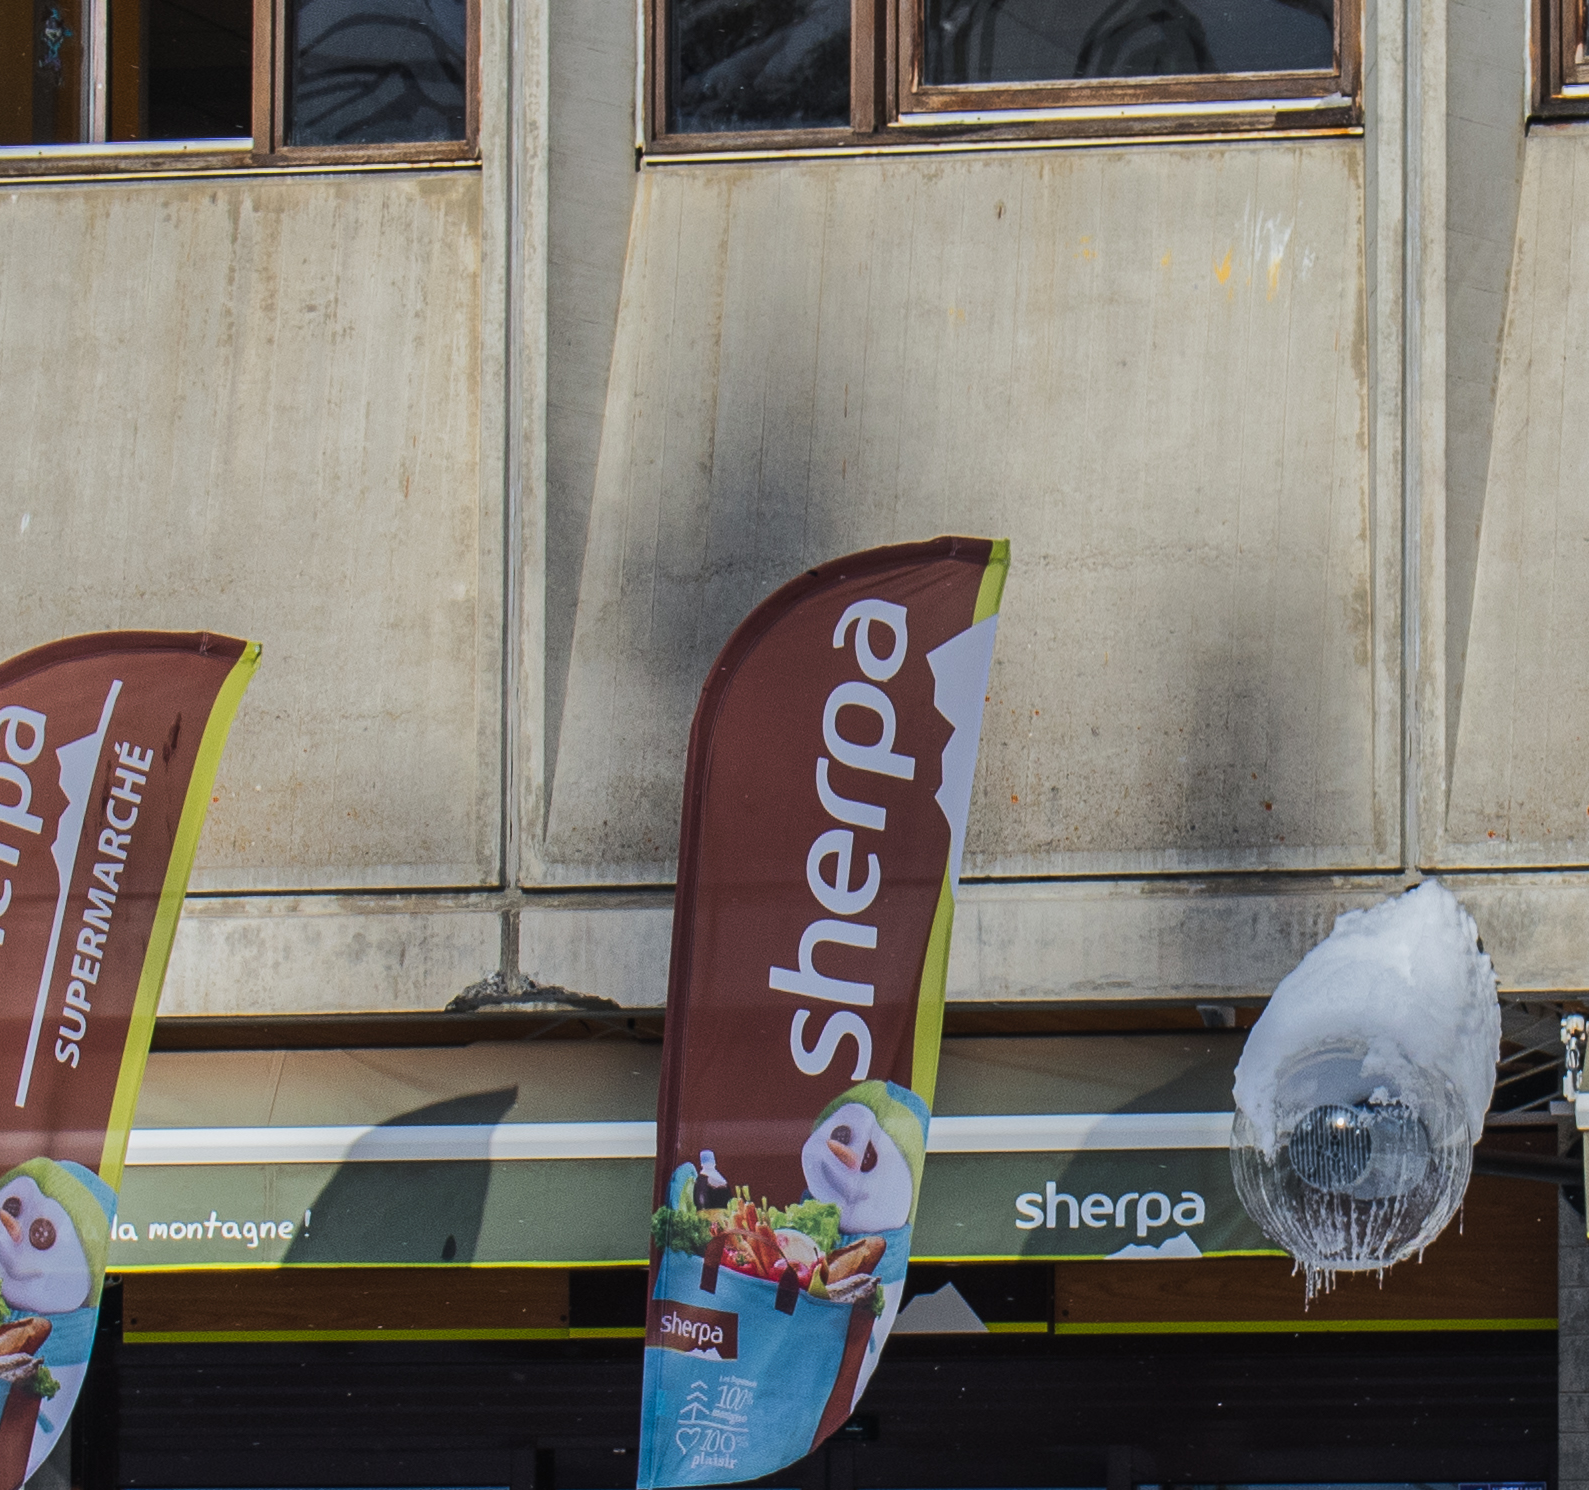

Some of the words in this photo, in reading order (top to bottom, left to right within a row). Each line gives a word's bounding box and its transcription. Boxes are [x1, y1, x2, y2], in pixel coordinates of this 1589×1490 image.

[769, 599, 915, 1081] sherpa
[56, 740, 154, 1068] SUPERMARCHÉ
[110, 1214, 138, 1241] la
[148, 1210, 294, 1248] montagne
[1015, 1180, 1205, 1237] sherpa
[660, 1311, 724, 1345] sherpa
